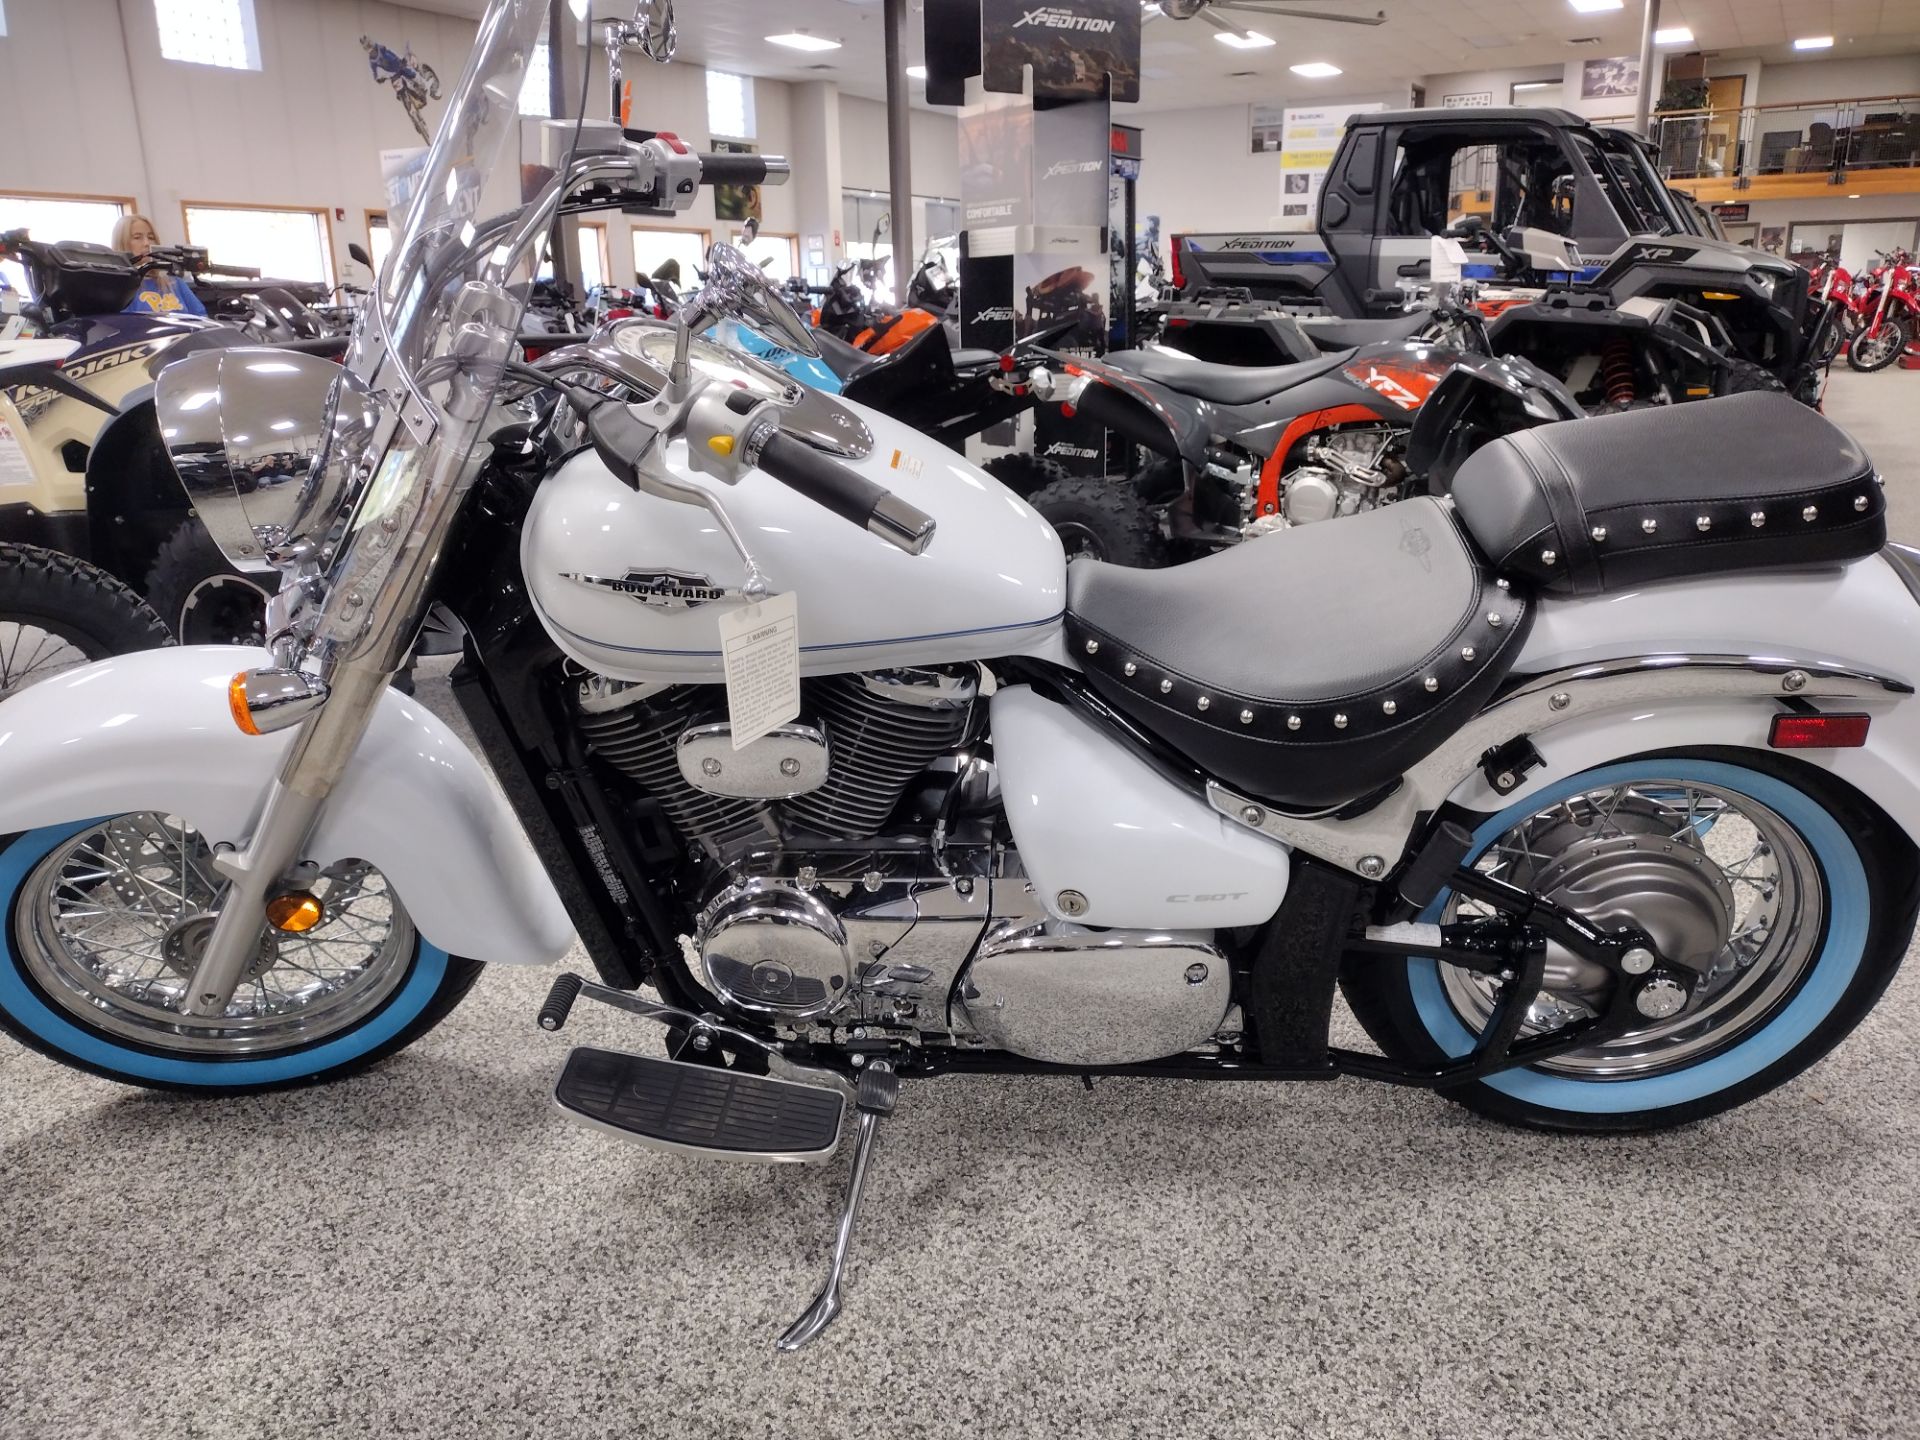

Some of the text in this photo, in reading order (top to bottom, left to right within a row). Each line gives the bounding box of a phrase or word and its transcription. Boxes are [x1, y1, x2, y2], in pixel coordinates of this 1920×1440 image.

[1012, 6, 1116, 33] XPEDITION
[1042, 160, 1103, 180] XPEDITION
[966, 204, 1013, 219] COMFORTABLE
[1217, 237, 1296, 251] XPEDITION
[1633, 247, 1673, 260] XP
[15, 347, 146, 402] KDIAK
[1364, 367, 1421, 409] YFZ
[1043, 441, 1099, 459] XPEDITION
[611, 582, 722, 600] BOULEVARD
[752, 625, 778, 641] WARNING
